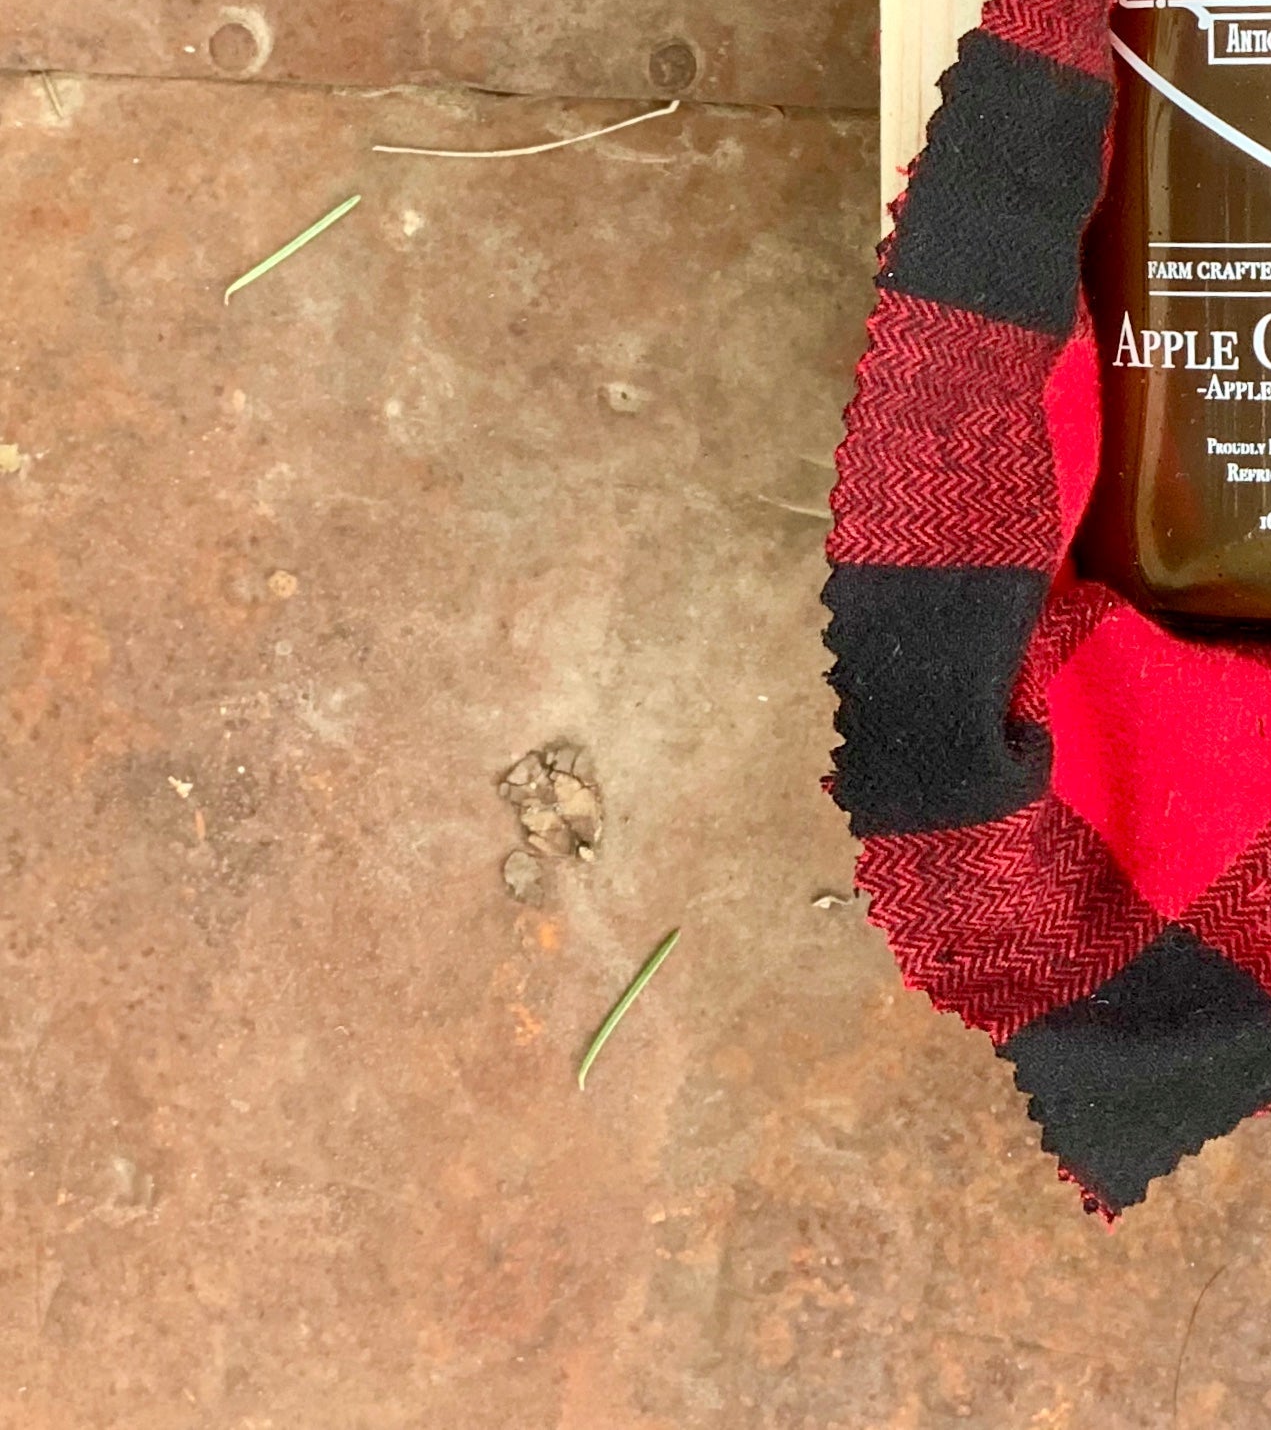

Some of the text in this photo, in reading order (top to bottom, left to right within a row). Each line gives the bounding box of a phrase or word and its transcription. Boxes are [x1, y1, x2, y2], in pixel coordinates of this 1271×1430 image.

[1148, 260, 1193, 280] FARM
[1113, 309, 1238, 370] APPLE
[1207, 437, 1266, 455] PROUDLY
